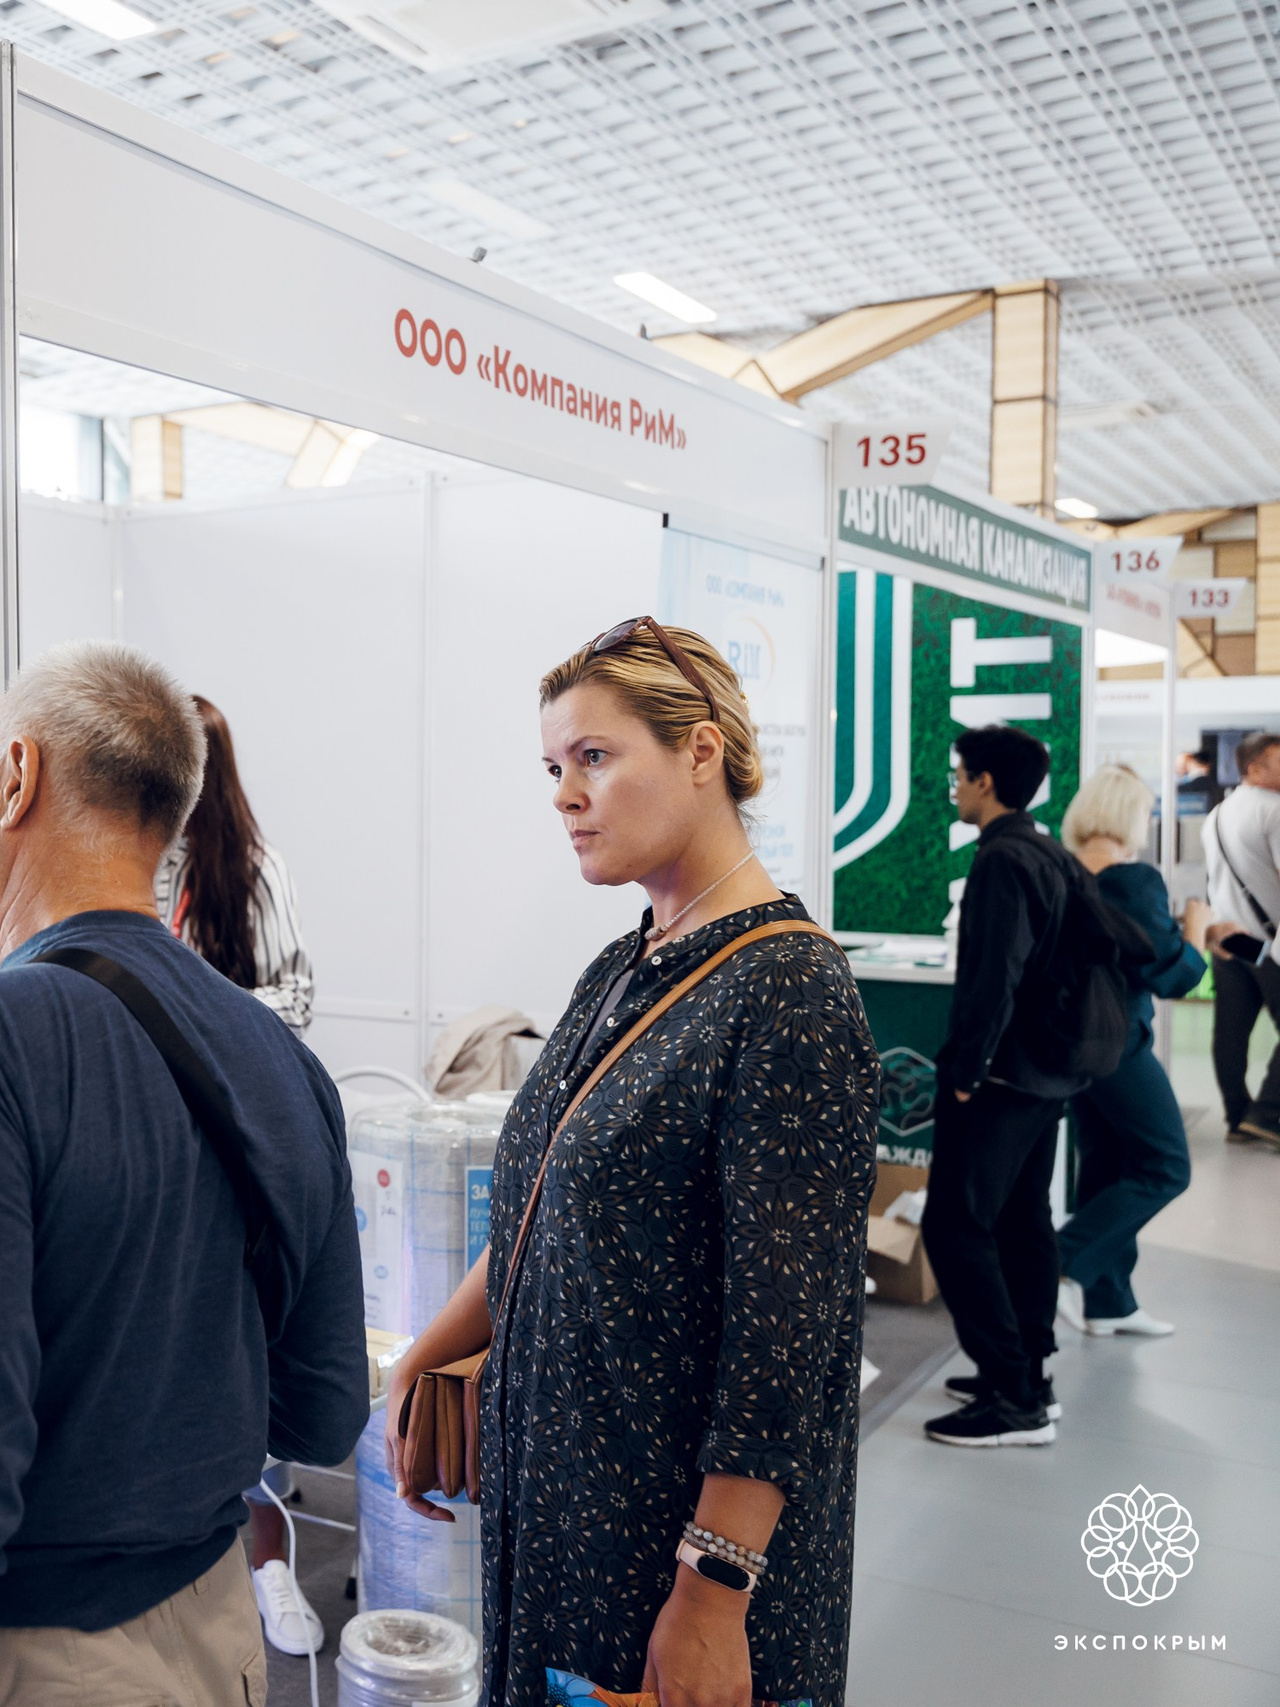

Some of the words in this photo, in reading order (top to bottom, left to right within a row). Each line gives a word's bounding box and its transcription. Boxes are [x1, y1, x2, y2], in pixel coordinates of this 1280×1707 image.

[394, 308, 467, 375] ООО
[477, 345, 621, 432] «Компания
[629, 398, 687, 450] РиМ»
[856, 432, 927, 468] 135
[842, 485, 981, 572] АВТОНОМНАЯ
[981, 520, 1088, 606] КАНАЛИЗАЦИЯ
[1111, 549, 1161, 573] 136
[1189, 588, 1230, 609] 133
